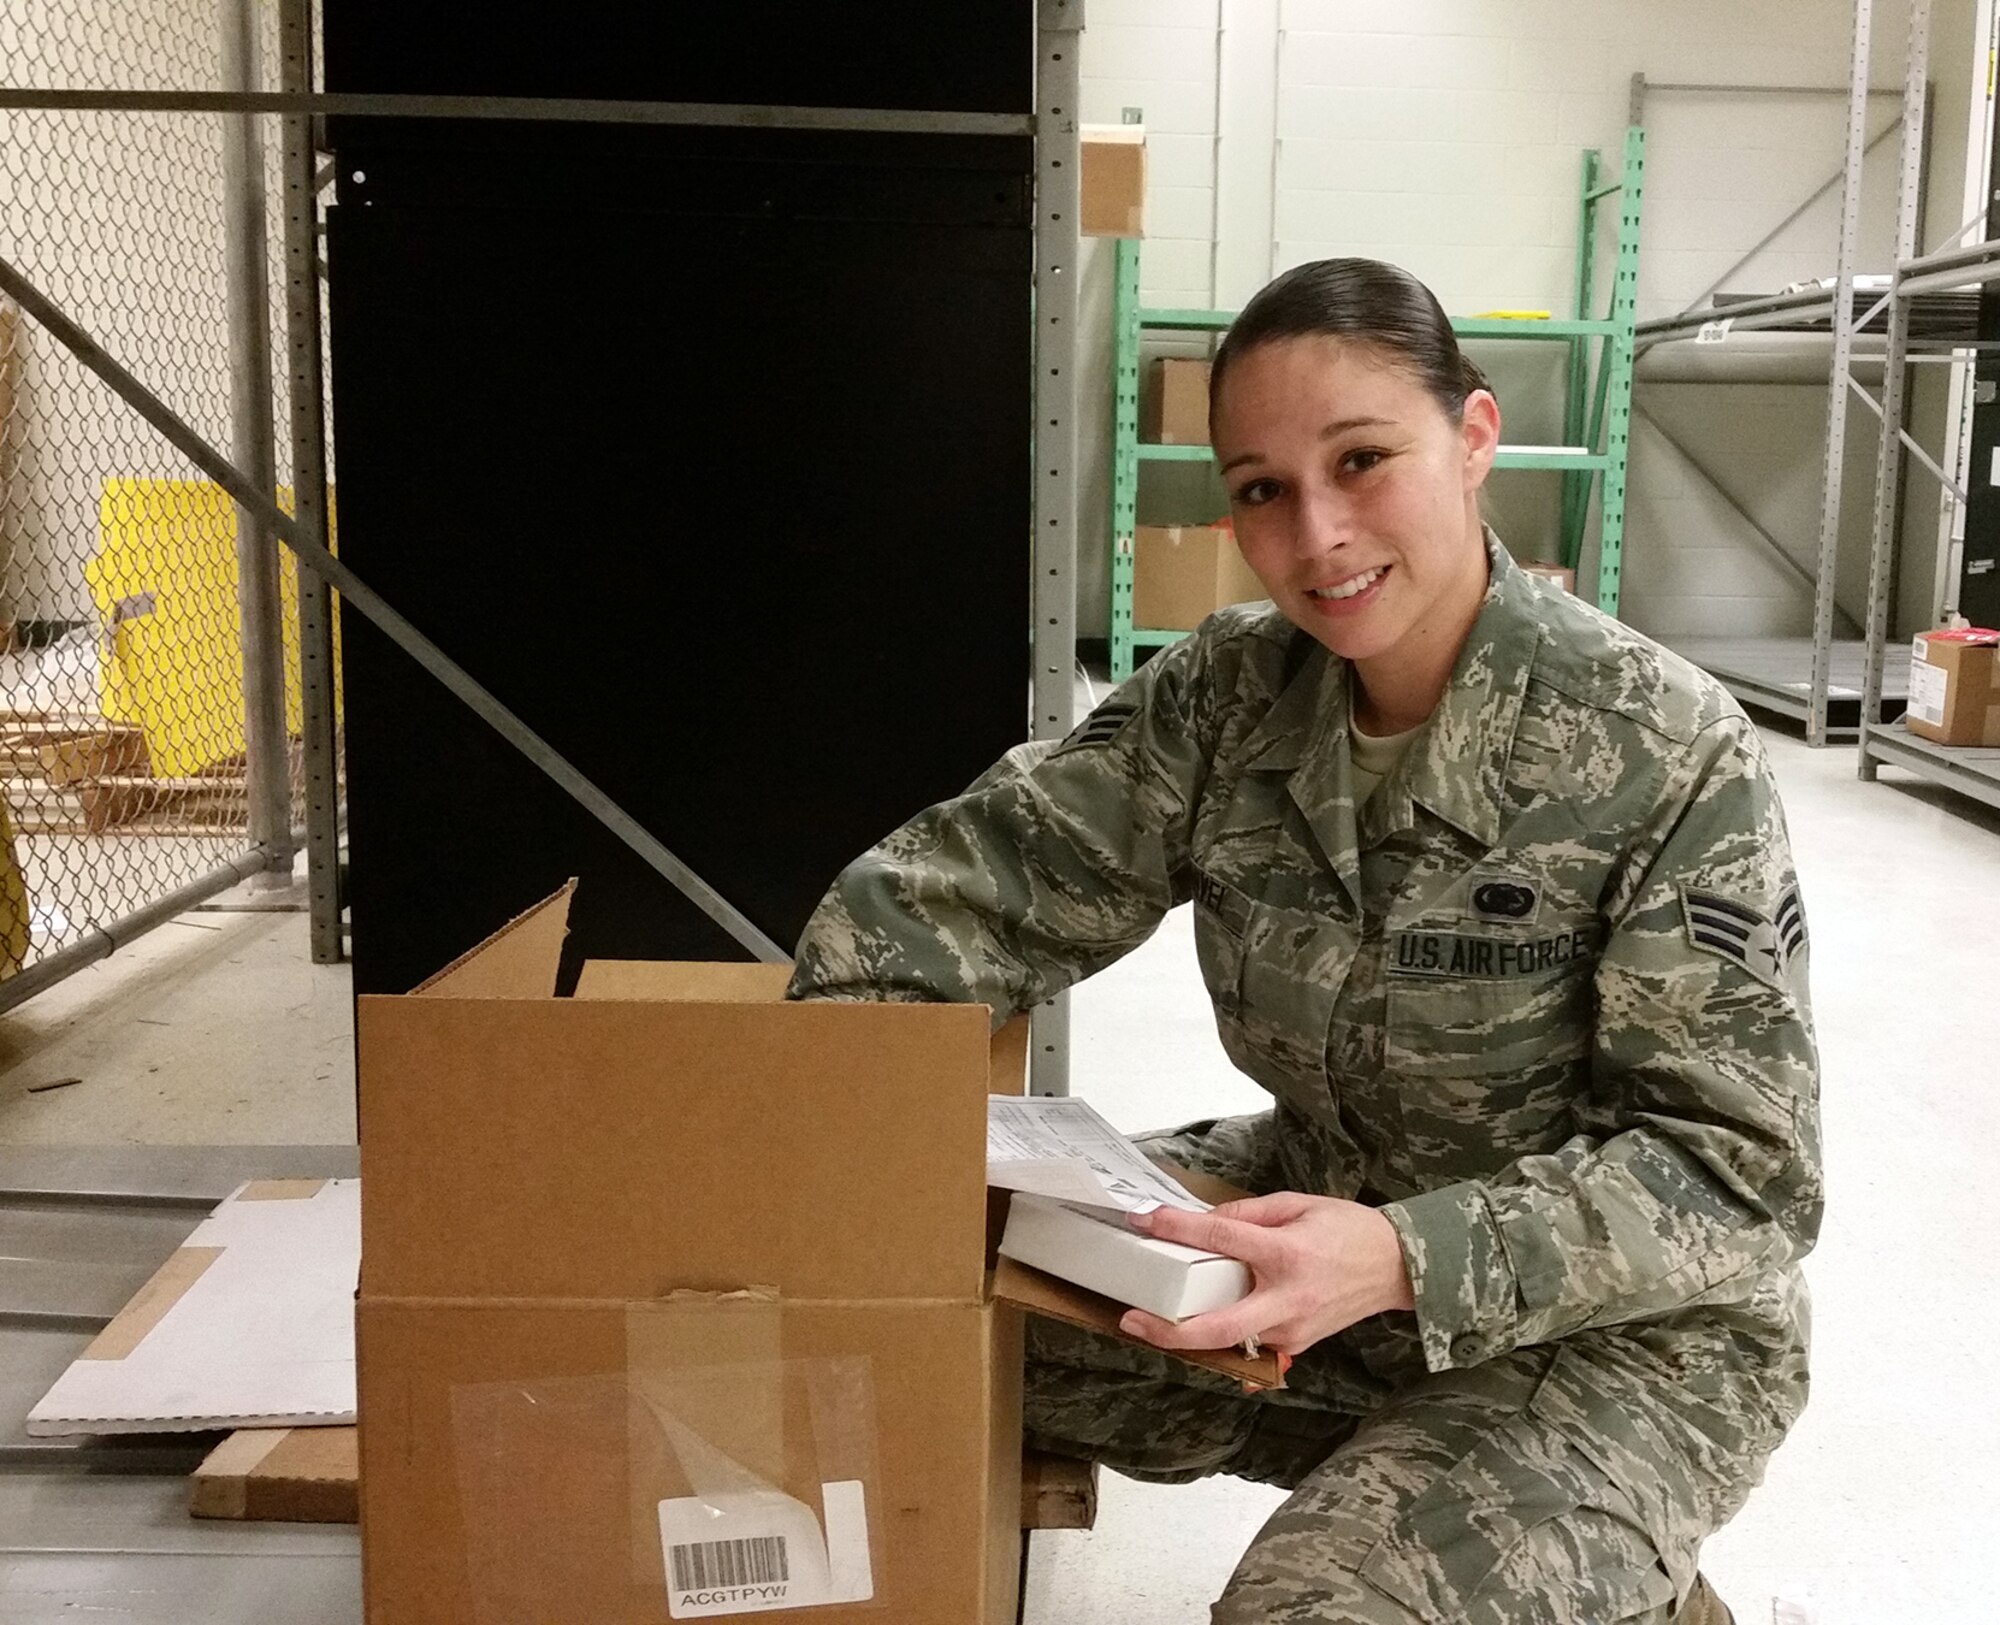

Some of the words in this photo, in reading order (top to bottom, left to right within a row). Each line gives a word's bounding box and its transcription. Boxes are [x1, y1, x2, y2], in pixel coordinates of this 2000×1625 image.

[1398, 934, 1445, 970] U.S.
[1450, 938, 1492, 975] AIR
[1499, 929, 1590, 976] FORCE
[681, 1585, 787, 1607] ACGTPYW
